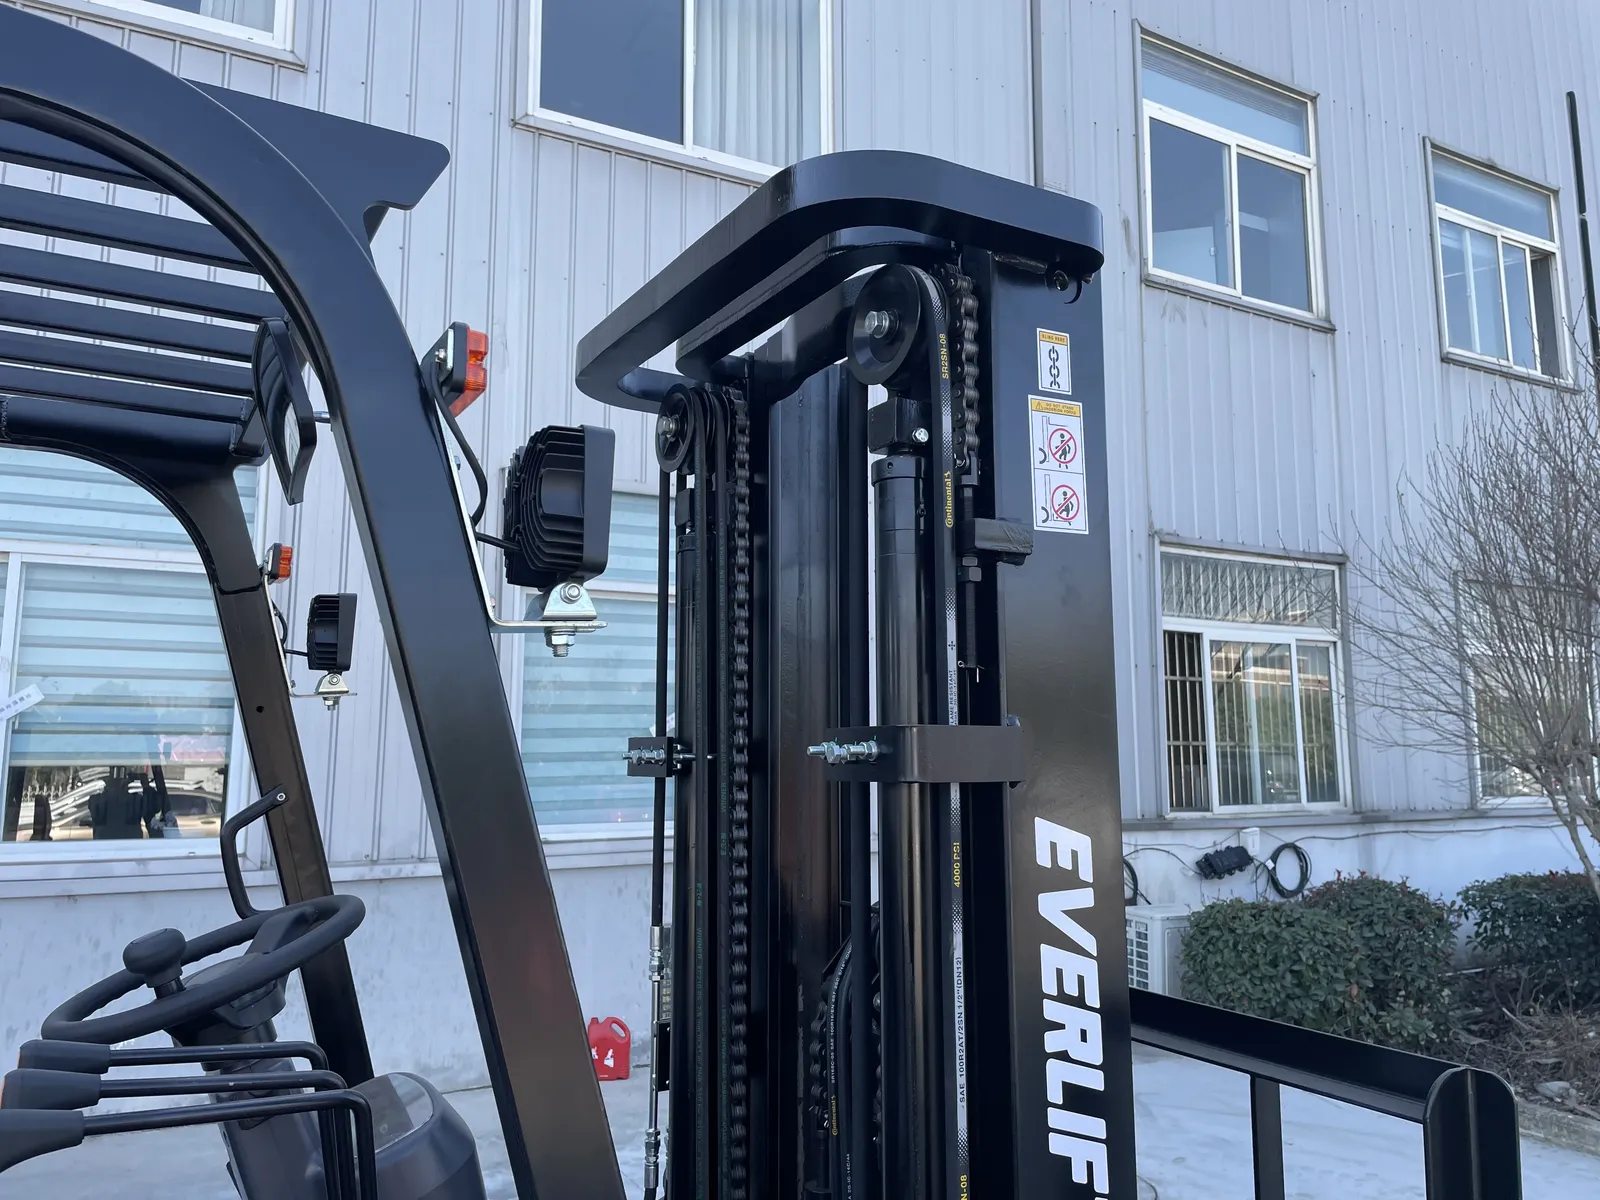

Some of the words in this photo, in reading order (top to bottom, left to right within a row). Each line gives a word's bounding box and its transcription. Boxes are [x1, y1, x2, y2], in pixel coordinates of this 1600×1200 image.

[939, 333, 949, 380] SR2SN-08
[945, 478, 954, 528] Continental
[953, 862, 961, 888] 4000
[1034, 816, 1109, 1200] EVERLIF
[957, 1012, 965, 1078] 100R2AT/2SN
